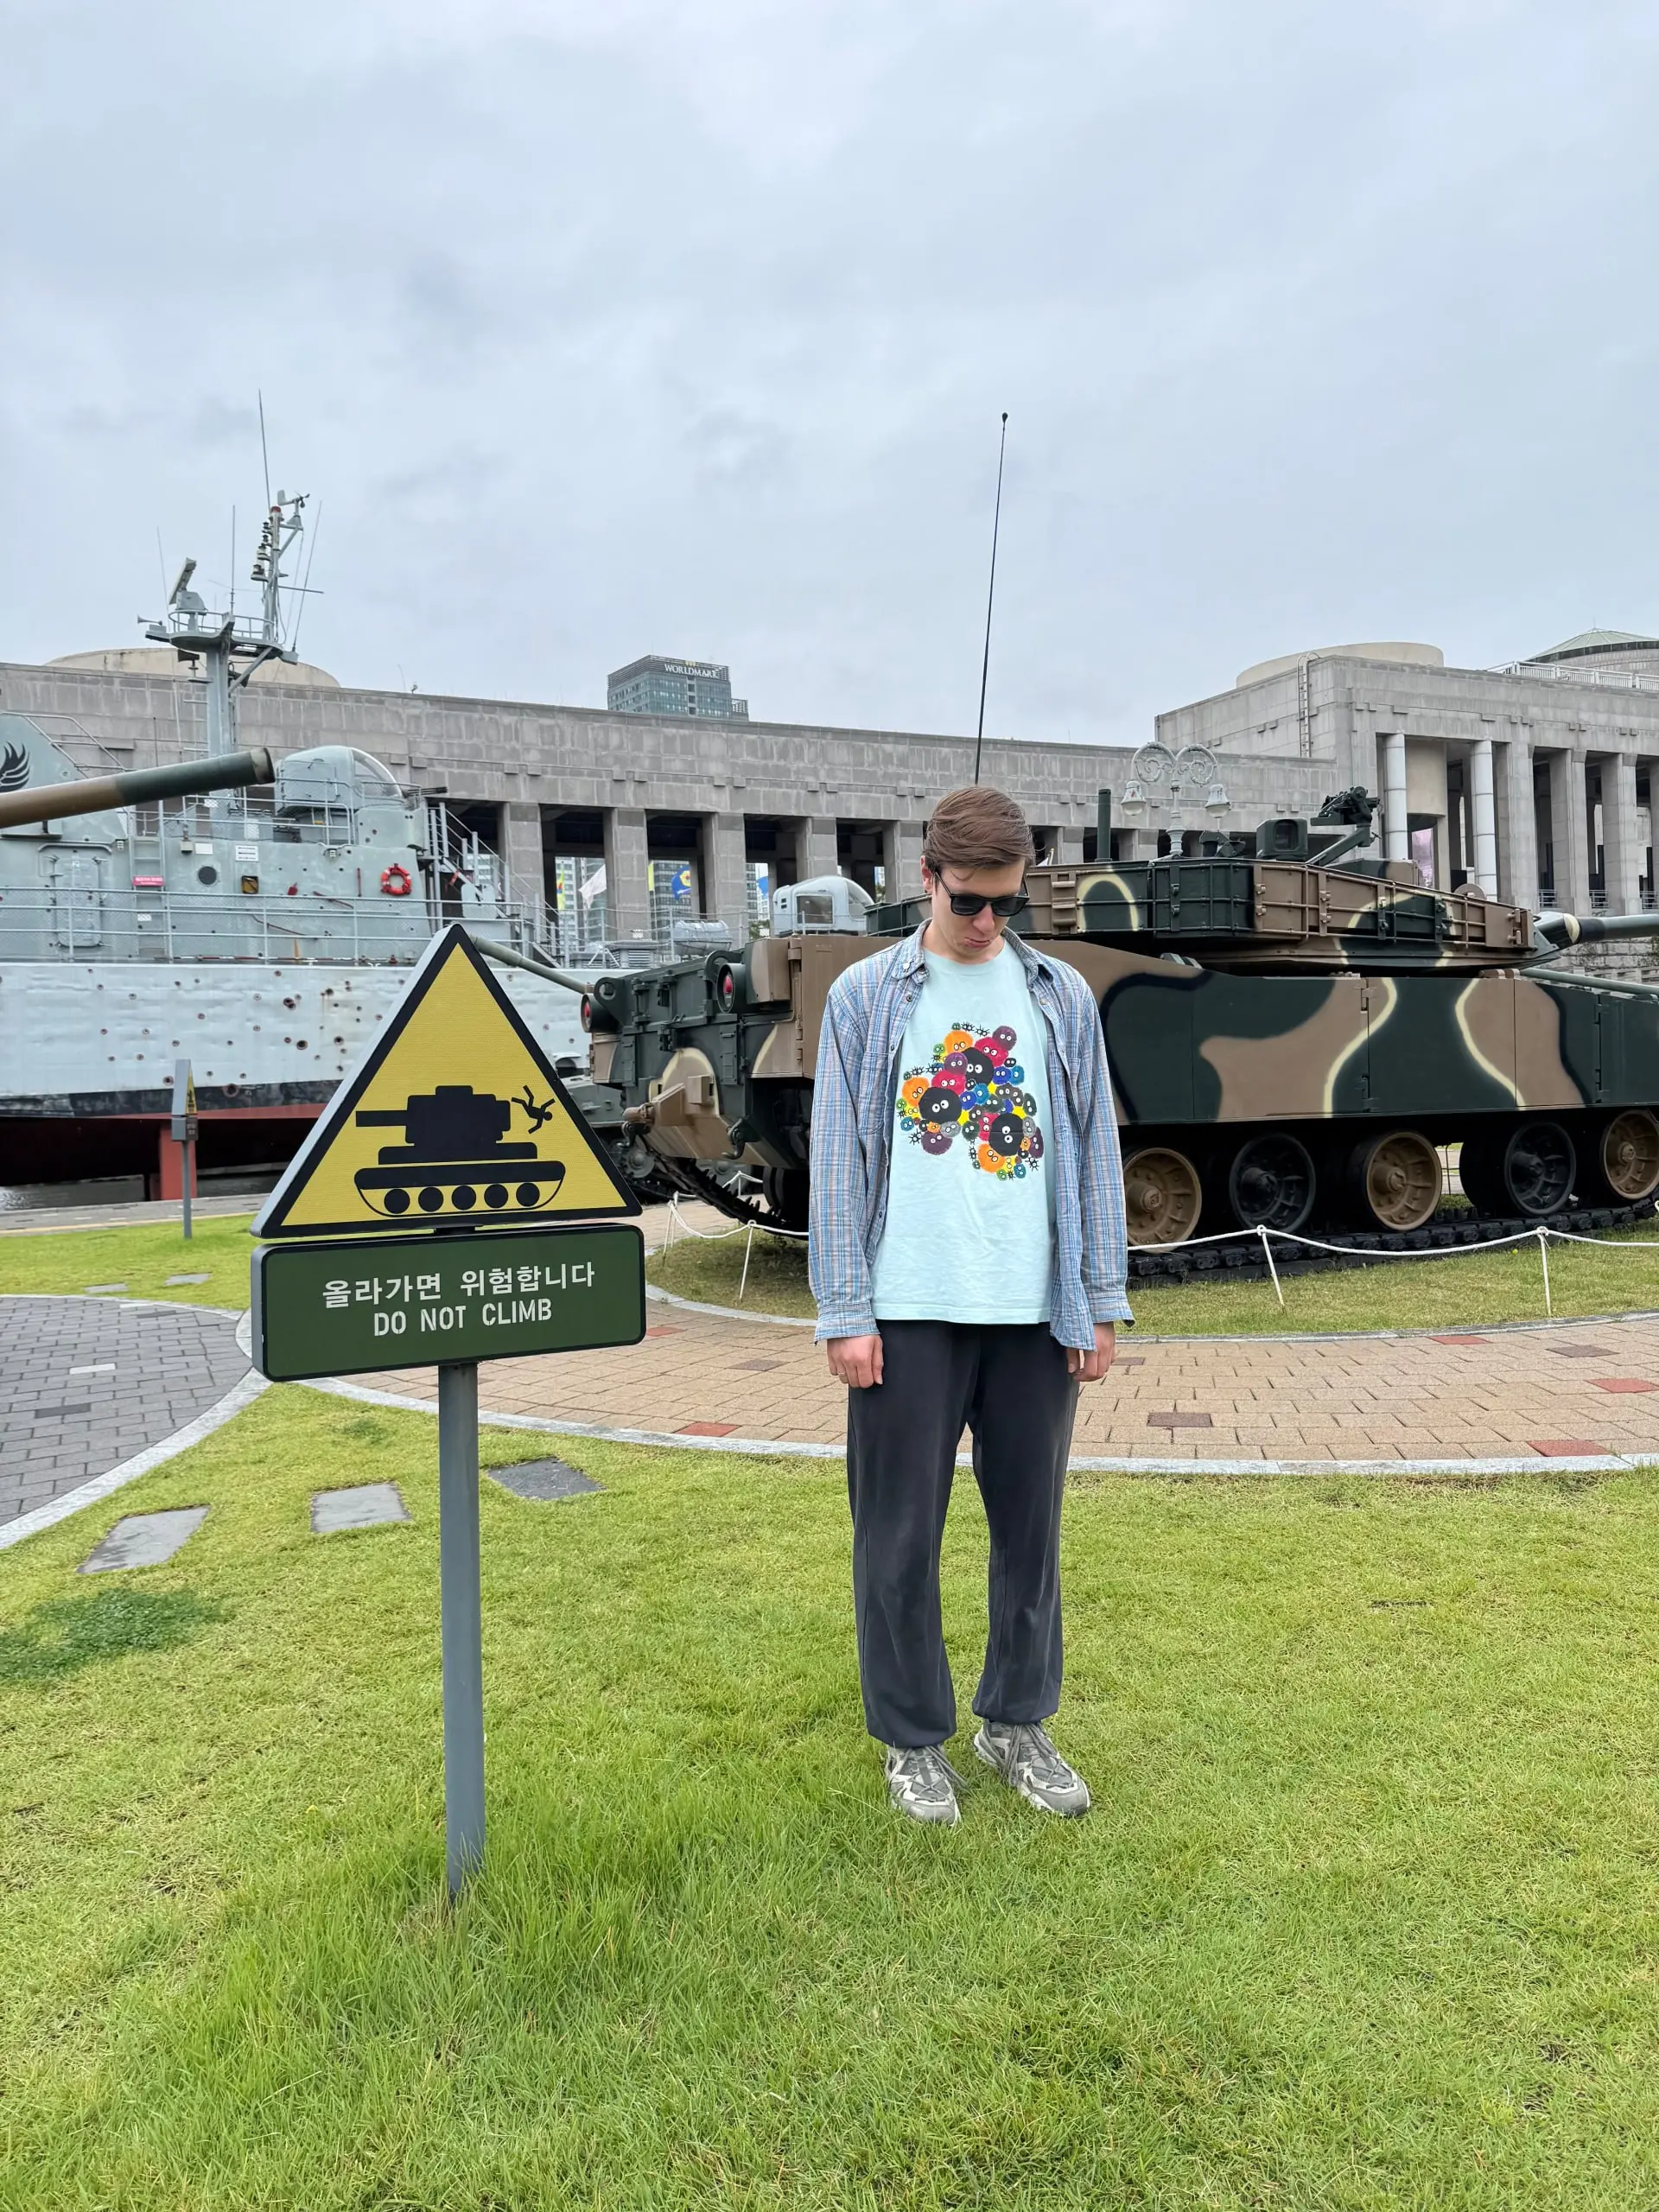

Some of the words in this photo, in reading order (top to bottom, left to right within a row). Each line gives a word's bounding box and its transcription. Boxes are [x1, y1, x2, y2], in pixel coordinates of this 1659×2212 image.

[664, 664, 719, 678] WORLDMARK
[322, 1272, 442, 1309] 올라가면
[460, 1261, 595, 1297] 위험합니다
[374, 1312, 407, 1337] DO
[420, 1305, 467, 1332] NOT
[482, 1298, 552, 1326] CLIMB
